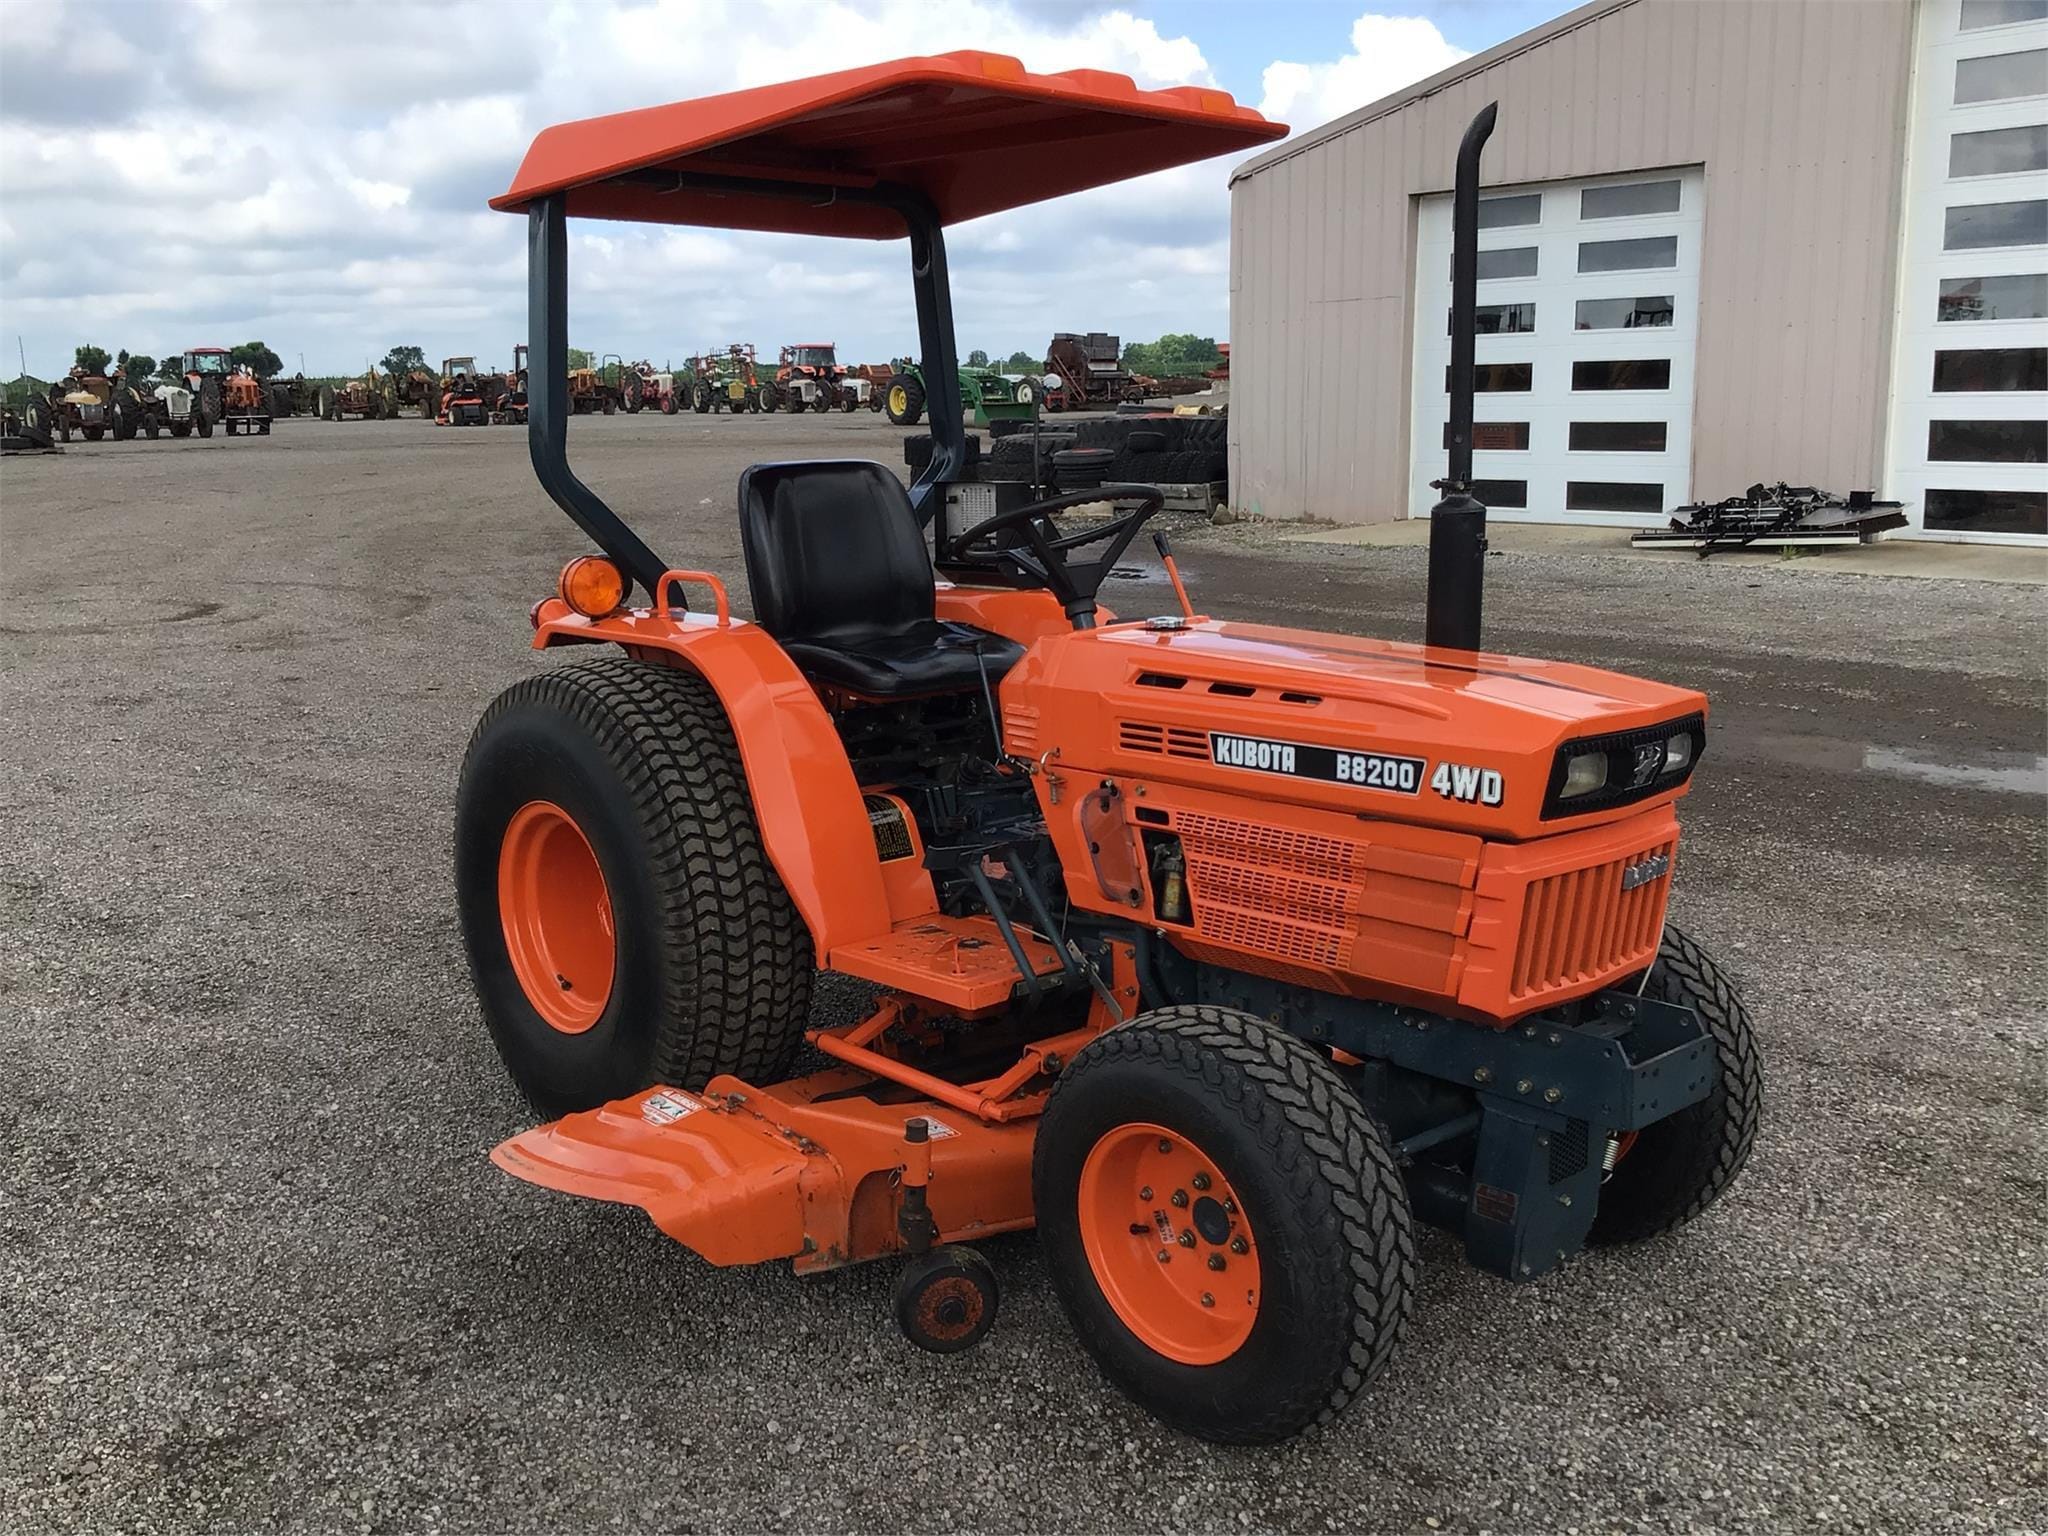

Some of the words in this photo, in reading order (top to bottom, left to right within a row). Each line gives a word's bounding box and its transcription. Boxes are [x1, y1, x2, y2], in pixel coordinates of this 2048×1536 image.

[1216, 736, 1296, 773] KUBOTA
[1336, 753, 1415, 790] B8200
[1431, 761, 1503, 806] 4WD
